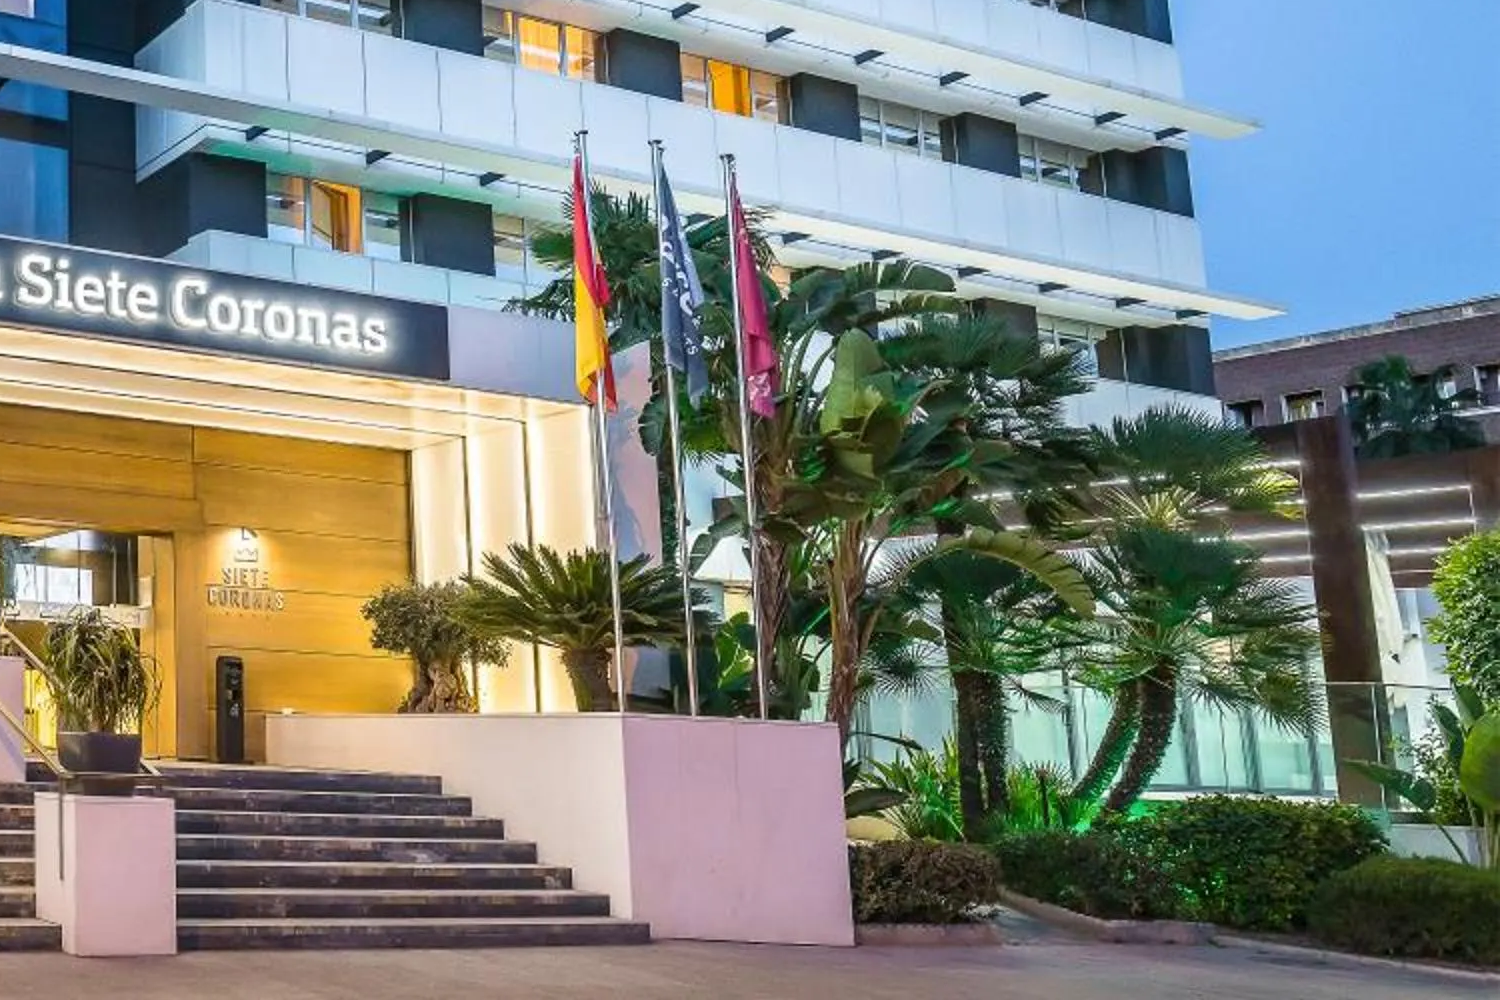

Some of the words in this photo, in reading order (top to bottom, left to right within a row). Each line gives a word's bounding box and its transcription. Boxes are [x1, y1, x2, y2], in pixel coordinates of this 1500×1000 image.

[17, 252, 159, 321] Siete
[171, 277, 388, 354] Coronas
[221, 567, 270, 589] SIETE
